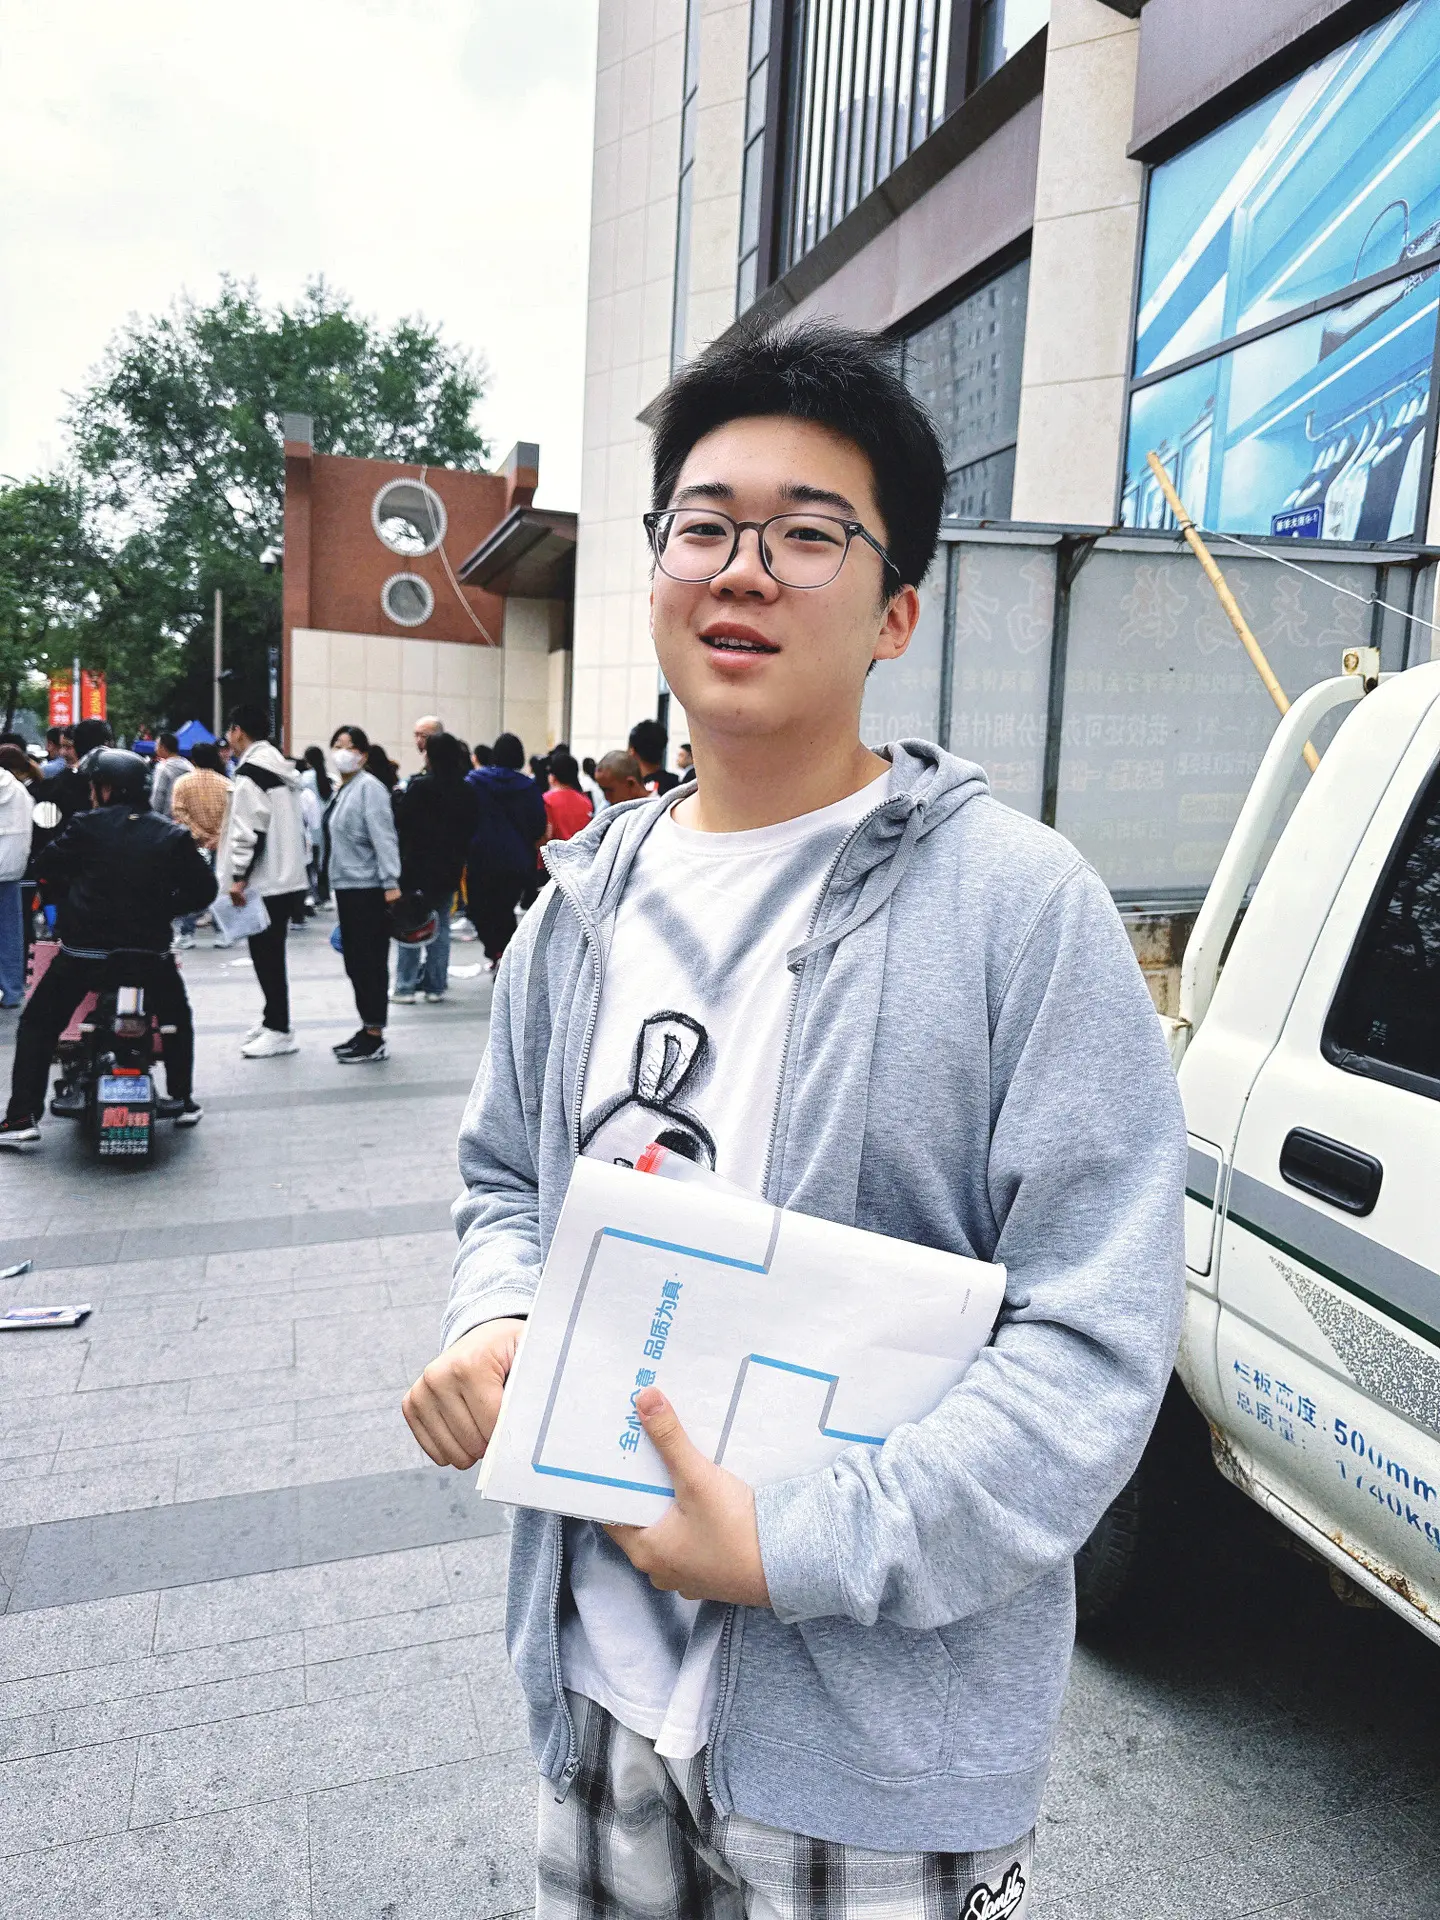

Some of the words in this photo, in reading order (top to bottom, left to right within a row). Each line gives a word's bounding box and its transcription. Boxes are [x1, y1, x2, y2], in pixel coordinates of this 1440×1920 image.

[619, 1367, 656, 1453] 全心意
[643, 1279, 684, 1360] 品质为真
